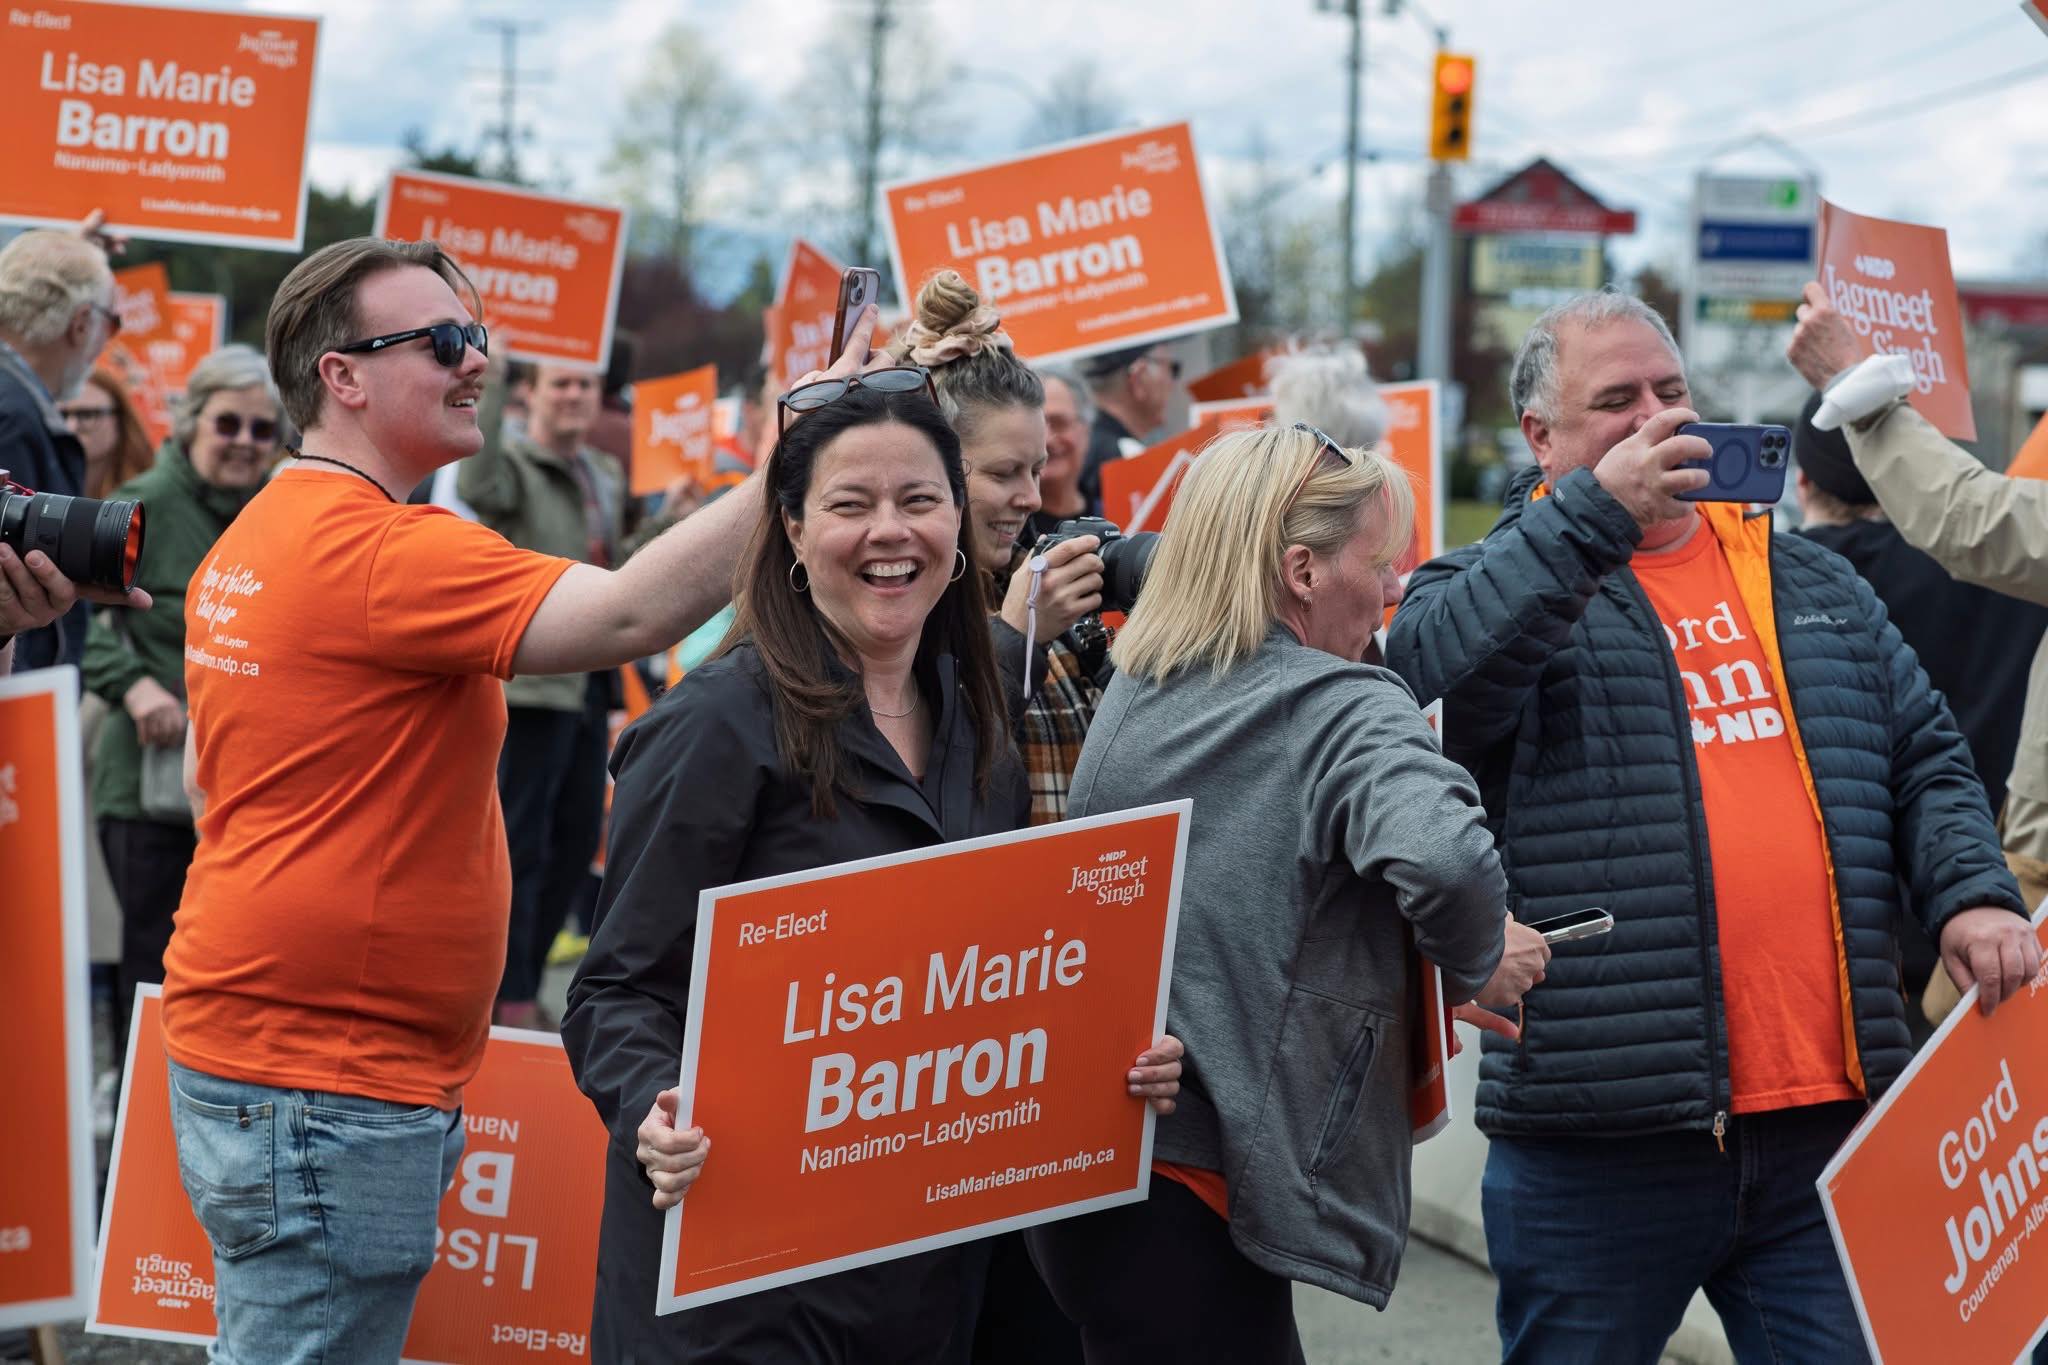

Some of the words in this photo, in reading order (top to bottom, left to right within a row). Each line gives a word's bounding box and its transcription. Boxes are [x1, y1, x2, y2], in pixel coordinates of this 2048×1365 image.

[40, 50, 125, 95] Lisa
[136, 59, 256, 107] Marie
[56, 98, 230, 160] Barron
[421, 214, 486, 257] Lisa
[490, 224, 580, 271] Marie
[946, 215, 1031, 259] Lisa
[1036, 184, 1152, 239] Marie
[456, 261, 558, 305] arron
[975, 234, 1143, 299] Barron
[1825, 264, 1938, 336] Jagmeet
[1716, 706, 1785, 745] ND
[1067, 855, 1149, 894] Jagmeet
[1106, 850, 1127, 862] NDP
[1096, 879, 1146, 906] Singh
[738, 909, 828, 947] Re-Elect
[783, 972, 903, 1045] Lisa
[923, 929, 1087, 1015] Marie
[804, 1027, 1049, 1134] Barron
[1938, 1057, 2020, 1190] Gord
[925, 1146, 1116, 1204] LisaMarieBarron.ndp.ca
[1943, 1115, 2048, 1294] Johns
[132, 1273, 216, 1304] agmeet
[135, 1253, 192, 1280] Singh
[491, 1324, 587, 1356] Re-Elect
